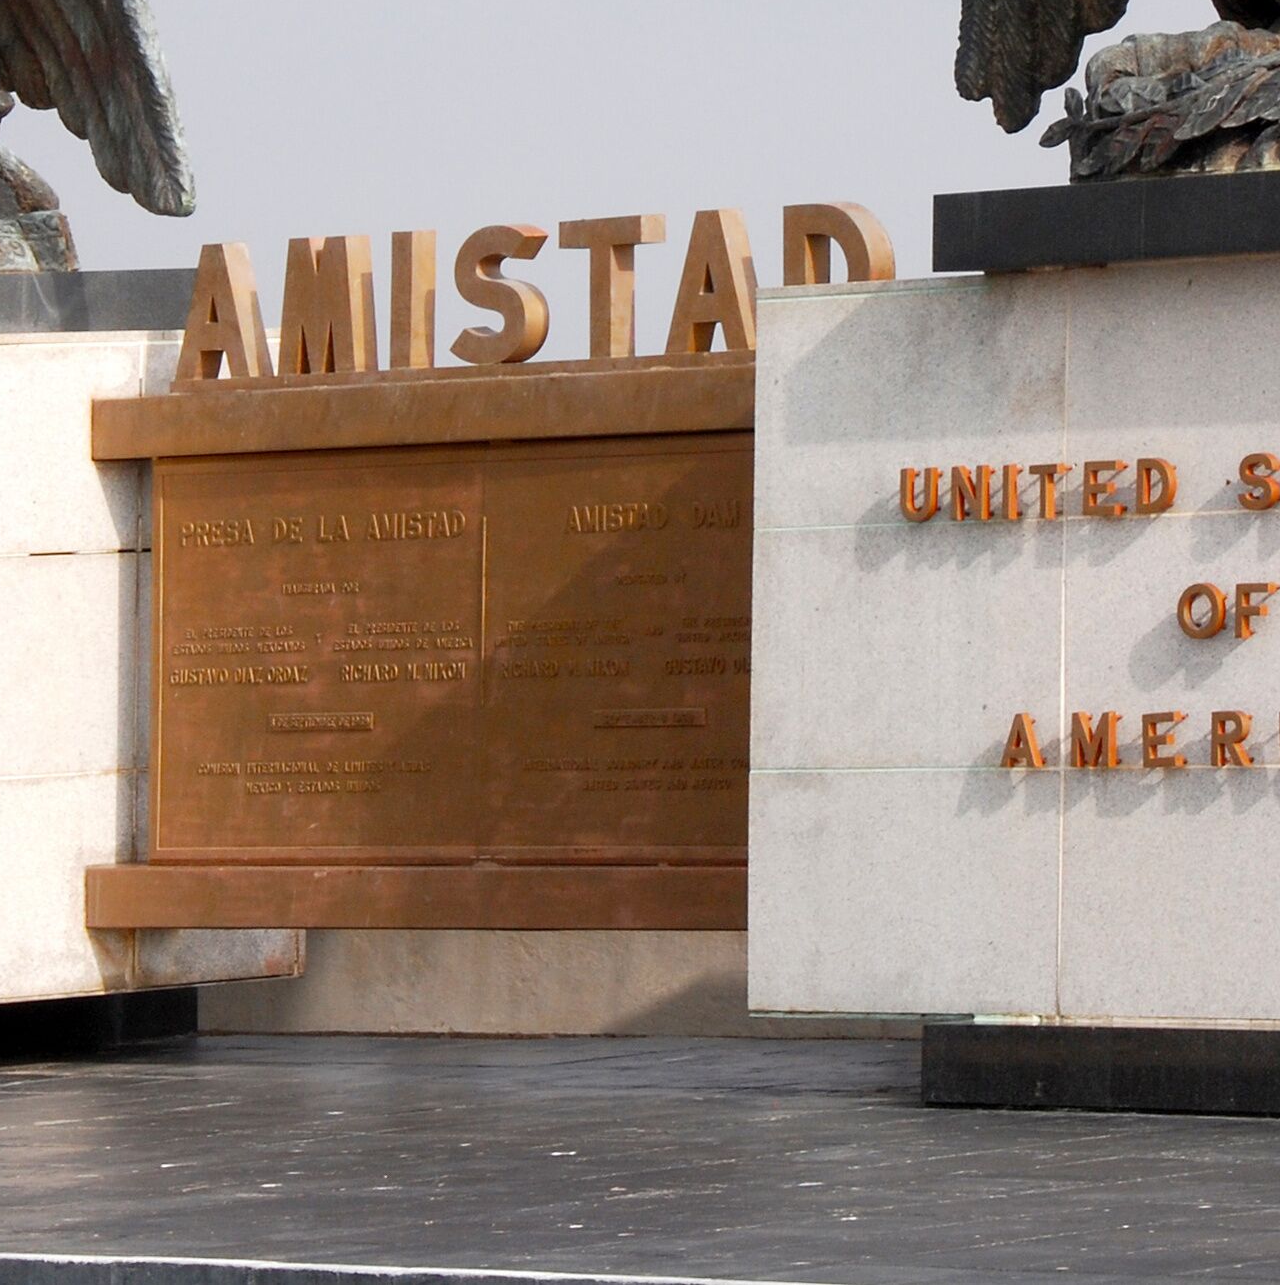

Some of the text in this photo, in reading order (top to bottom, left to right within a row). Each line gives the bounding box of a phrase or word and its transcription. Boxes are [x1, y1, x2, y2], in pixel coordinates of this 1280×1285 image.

[176, 202, 895, 379] AMISTAD
[899, 457, 1179, 522] UNITED
[180, 510, 466, 548] PRESA DE LA AMISTAD
[567, 499, 742, 535] AMISTAD DAM
[1177, 581, 1280, 639] OF
[170, 664, 309, 686] GUSTAVO DIAZ ORDAZ
[341, 662, 399, 683] RICHARD
[424, 661, 467, 682] NIXON
